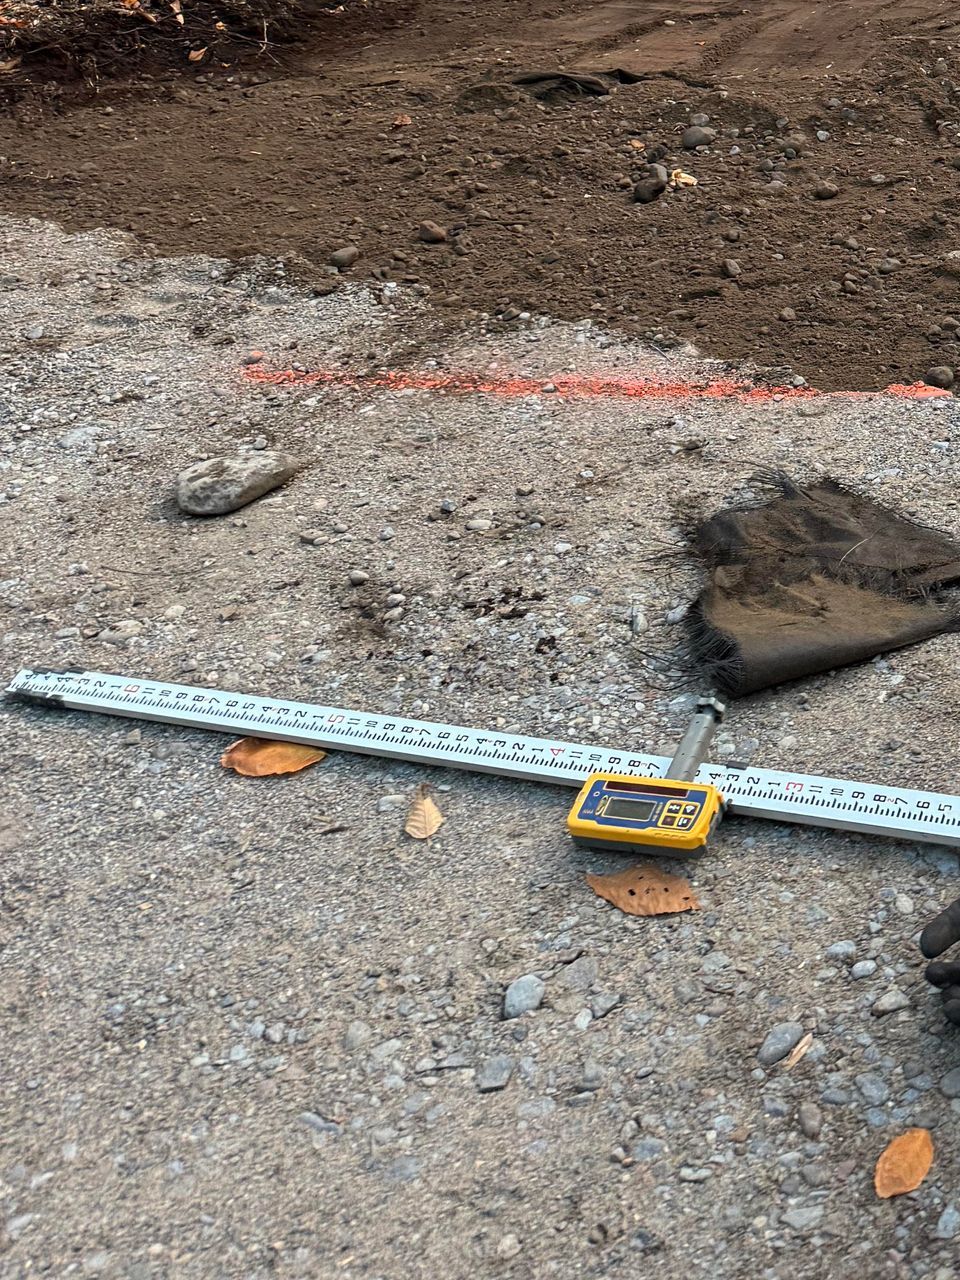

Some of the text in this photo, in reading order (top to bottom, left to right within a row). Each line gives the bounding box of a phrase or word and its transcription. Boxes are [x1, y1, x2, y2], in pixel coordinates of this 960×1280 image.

[94, 679, 107, 687] 2
[175, 691, 188, 699] 9
[192, 694, 205, 702] 8
[226, 699, 239, 707] 6
[242, 702, 256, 710] 5
[277, 707, 290, 715] 3
[294, 710, 308, 718] 2
[347, 717, 361, 725] 11
[364, 720, 378, 728] 10
[383, 722, 396, 730] 9
[401, 725, 414, 733] 8
[419, 728, 431, 736] 7
[437, 731, 451, 739] 6
[455, 734, 469, 742] 5
[476, 737, 488, 745] 4
[493, 739, 507, 748] 3
[512, 742, 525, 751] 2
[550, 748, 566, 756] 4
[569, 751, 583, 759] 11
[588, 753, 602, 762] 10
[608, 756, 622, 764] 9
[628, 759, 641, 767] 8
[647, 762, 661, 770] 7
[708, 772, 722, 780] 4
[726, 773, 740, 782] 3
[747, 776, 761, 785] 2
[785, 781, 804, 792] 3
[809, 785, 823, 793] 11
[830, 788, 844, 796] 10
[851, 791, 865, 800] 9
[873, 794, 887, 803] 8
[894, 797, 908, 805] 7
[916, 800, 931, 809] 6
[937, 803, 952, 812] 5
